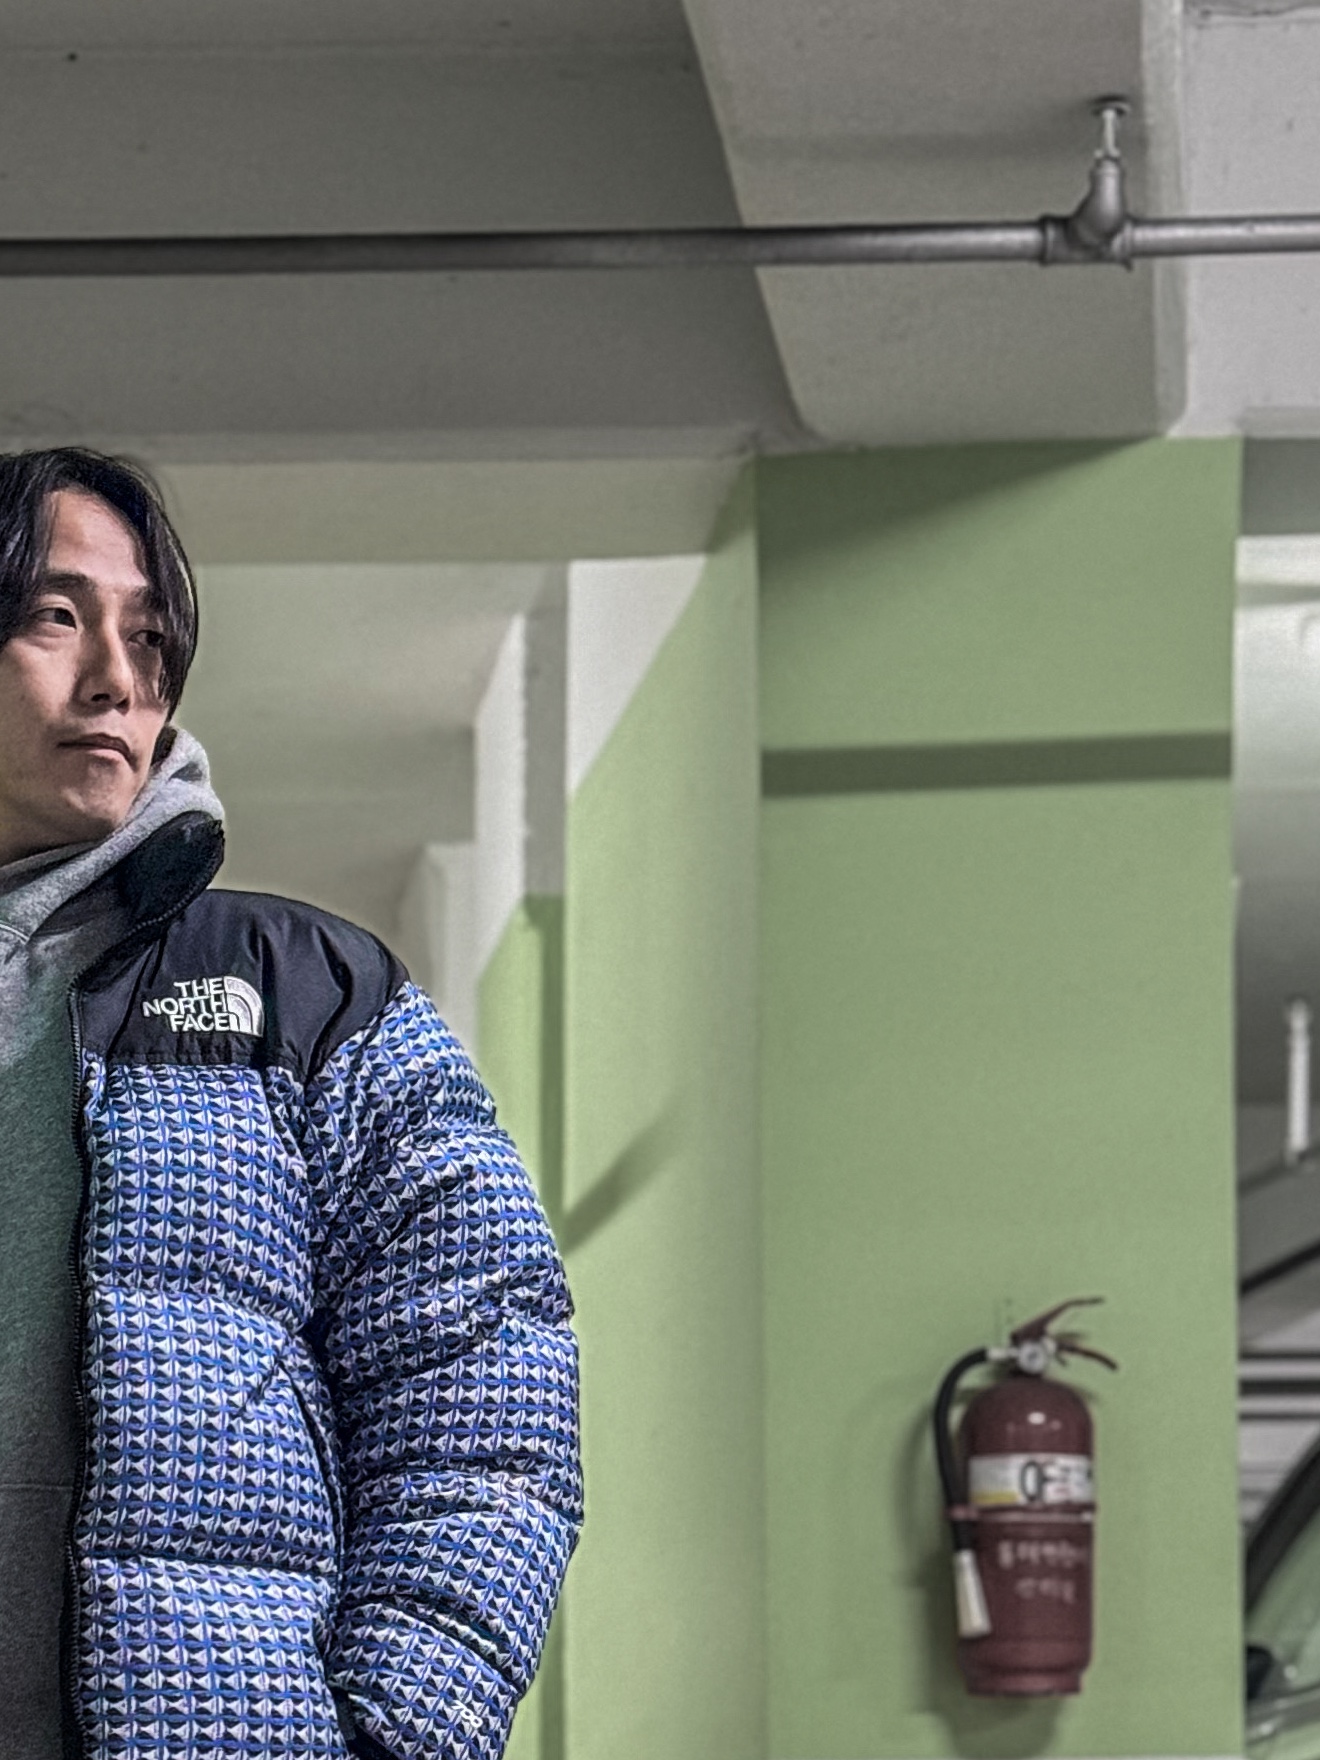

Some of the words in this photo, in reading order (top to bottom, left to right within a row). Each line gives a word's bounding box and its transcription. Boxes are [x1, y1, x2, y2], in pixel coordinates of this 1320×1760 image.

[173, 977, 225, 998] THE
[142, 994, 228, 1018] NORTH
[170, 1012, 230, 1033] FACE
[450, 1699, 484, 1728] 700
